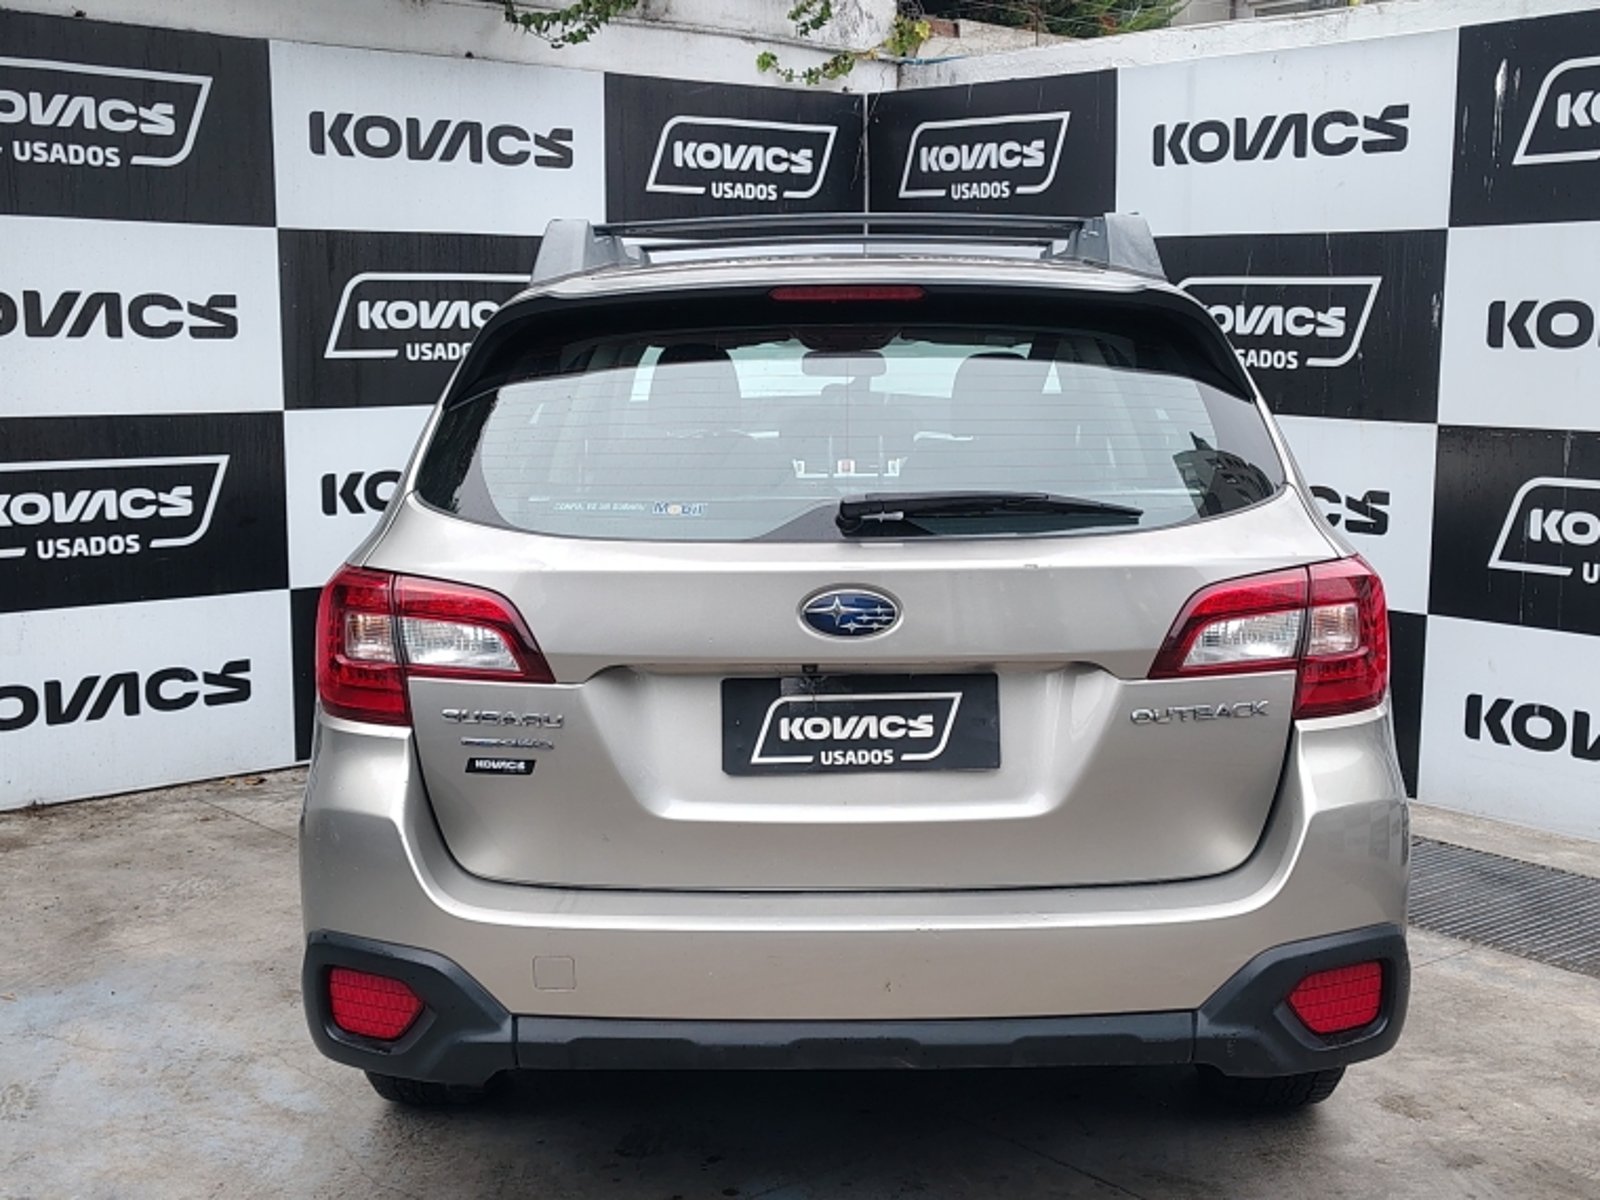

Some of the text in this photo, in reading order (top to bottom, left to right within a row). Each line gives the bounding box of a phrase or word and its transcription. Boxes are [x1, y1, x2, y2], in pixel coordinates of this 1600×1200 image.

[1557, 90, 1600, 128] K
[308, 111, 574, 169] KOVACS
[1153, 103, 1409, 167] KOVACS
[13, 140, 121, 168] USADOS
[673, 140, 814, 174] KOVACS
[920, 139, 1046, 172] KOVACS
[711, 182, 778, 201] USADOS
[951, 182, 1010, 200] USADOS
[1203, 305, 1346, 338] OVACS
[37, 534, 140, 560] USADOS
[442, 709, 564, 728] SUBARU
[1131, 701, 1269, 725] OUTBACK
[780, 715, 934, 741] KOVACS
[820, 749, 894, 765] USADOS
